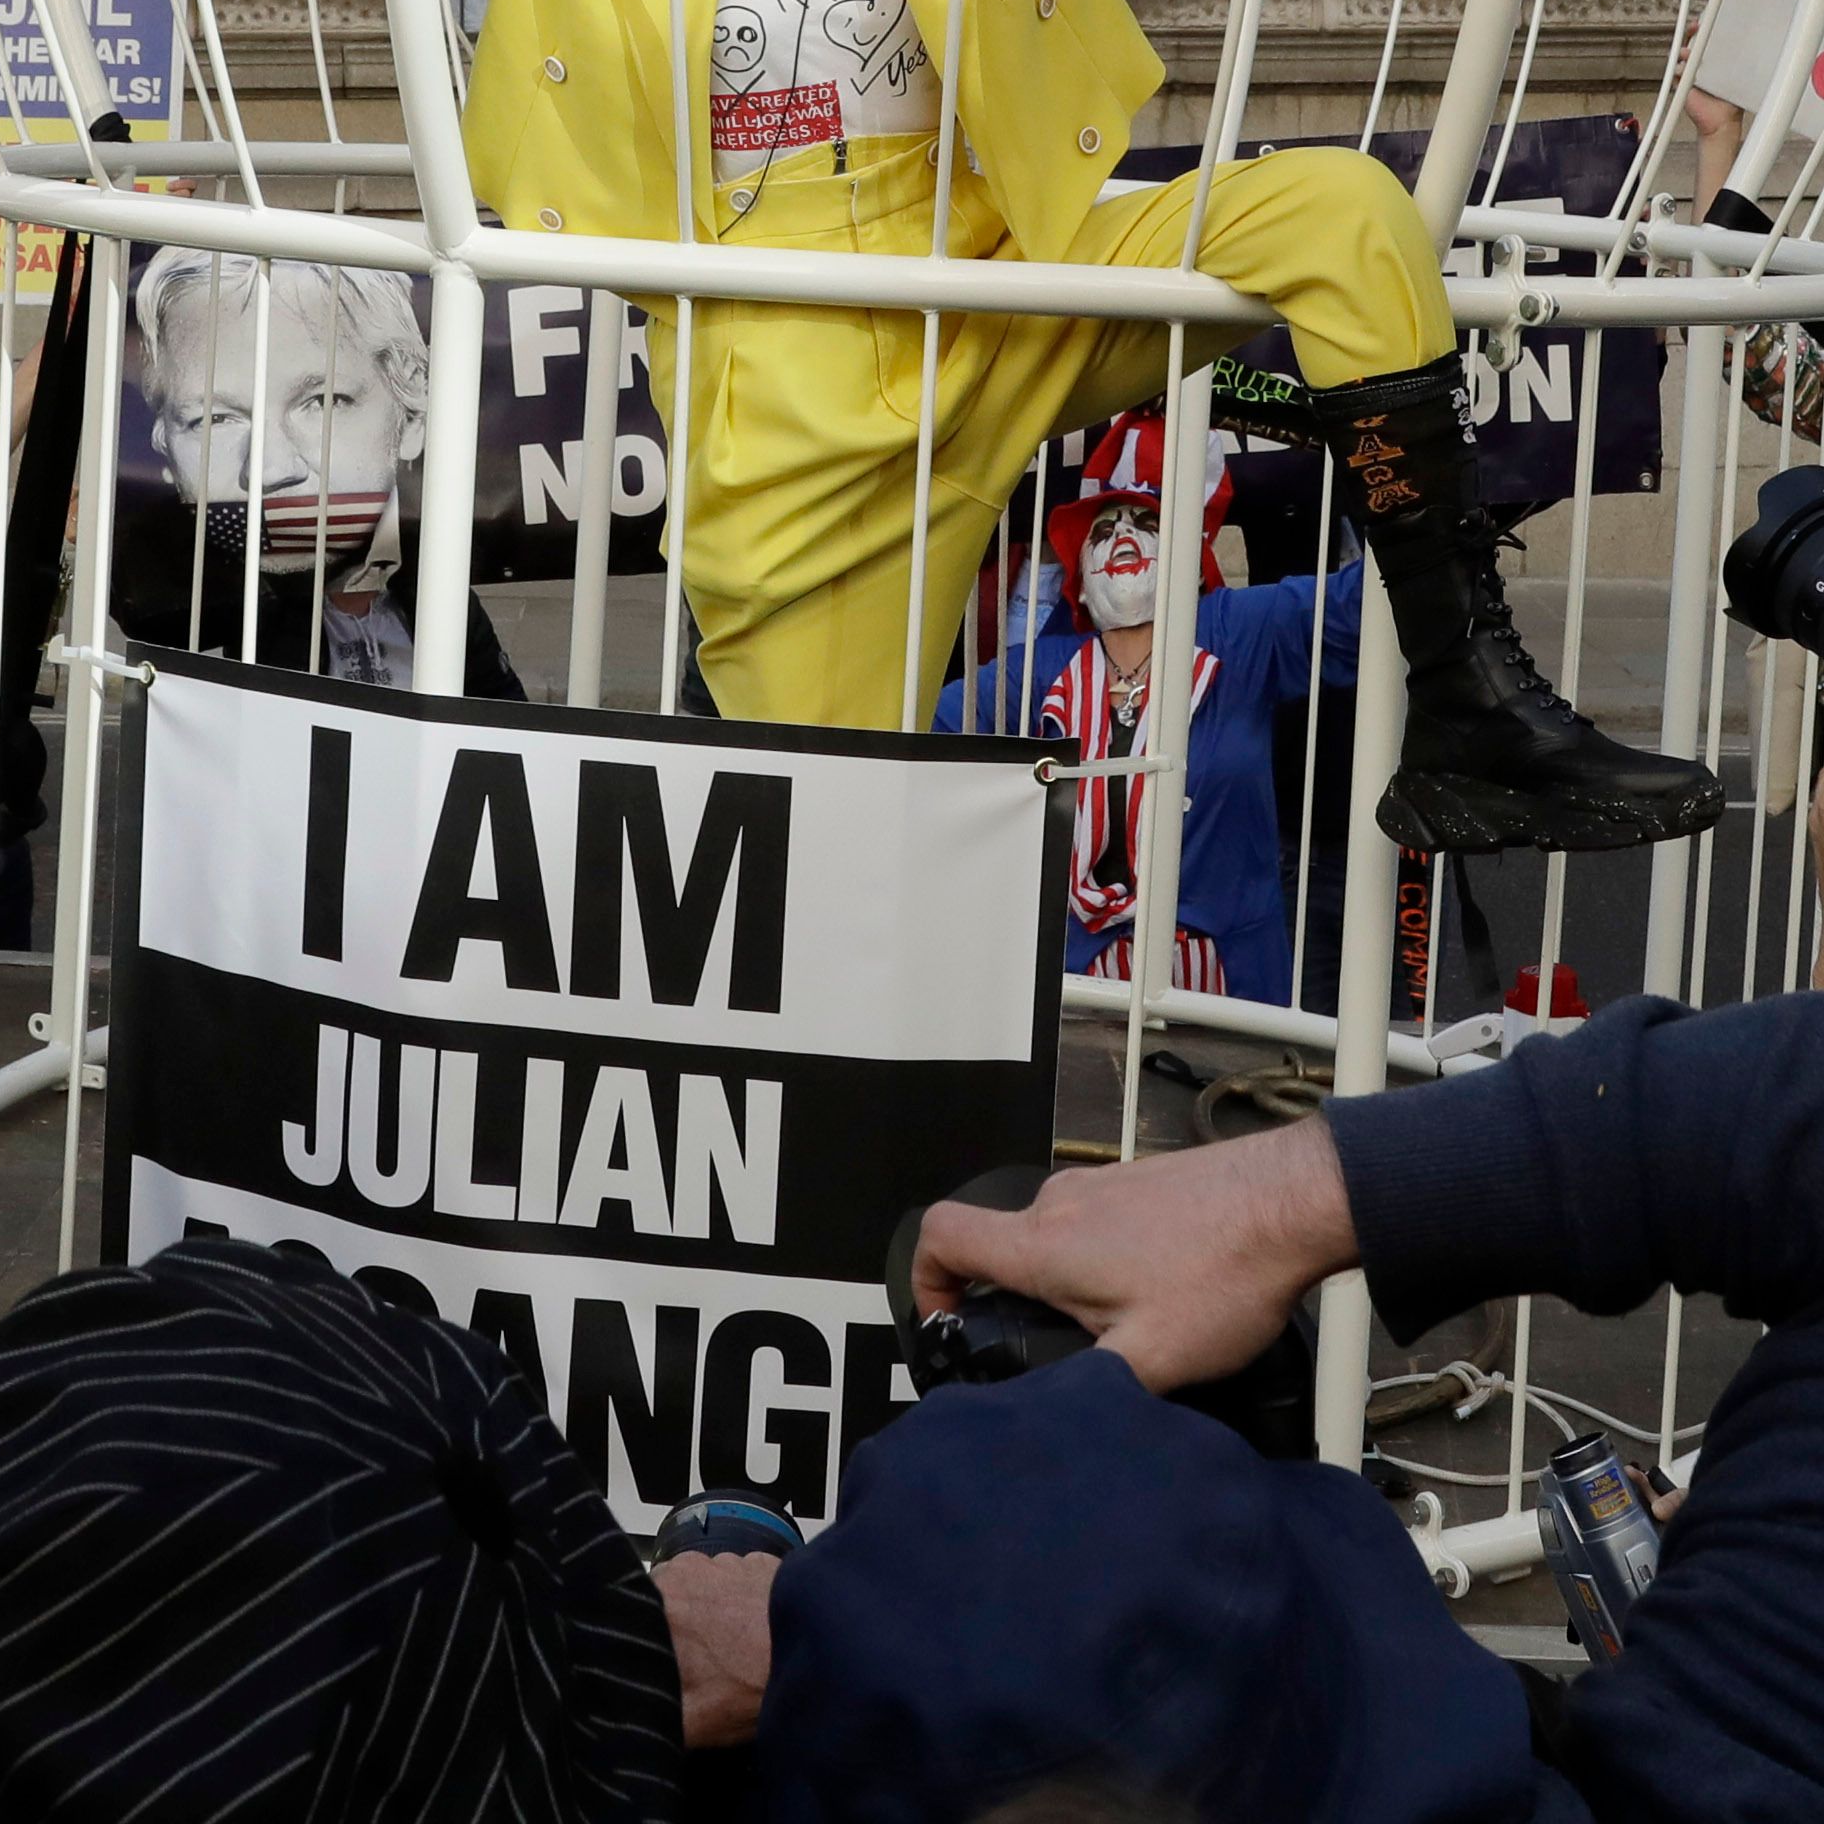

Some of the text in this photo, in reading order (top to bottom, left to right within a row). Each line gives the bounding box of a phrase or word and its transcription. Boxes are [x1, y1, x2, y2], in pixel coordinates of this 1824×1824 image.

[747, 87, 832, 110] CREATED
[519, 433, 667, 525] NO
[302, 725, 793, 1015] I AM
[282, 1022, 784, 1247] JULIAN
